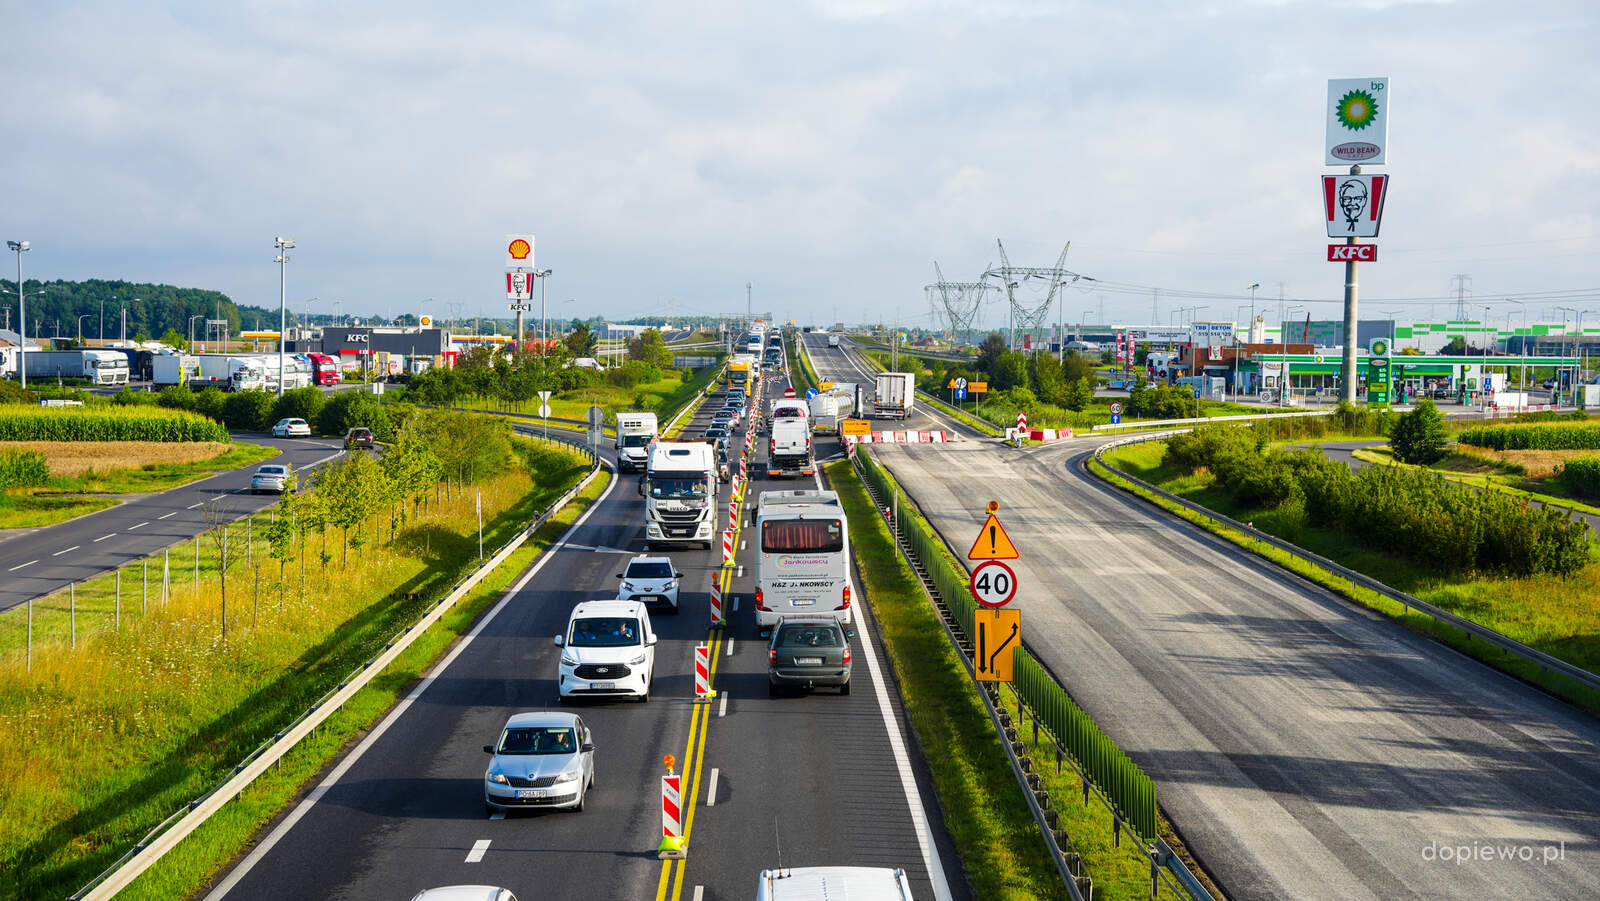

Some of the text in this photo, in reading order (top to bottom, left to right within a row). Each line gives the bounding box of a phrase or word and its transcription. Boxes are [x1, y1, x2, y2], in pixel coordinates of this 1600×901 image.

[1371, 81, 1384, 92] bp
[1331, 246, 1370, 259] KFC
[347, 334, 368, 342] KFC
[976, 573, 1009, 595] 40
